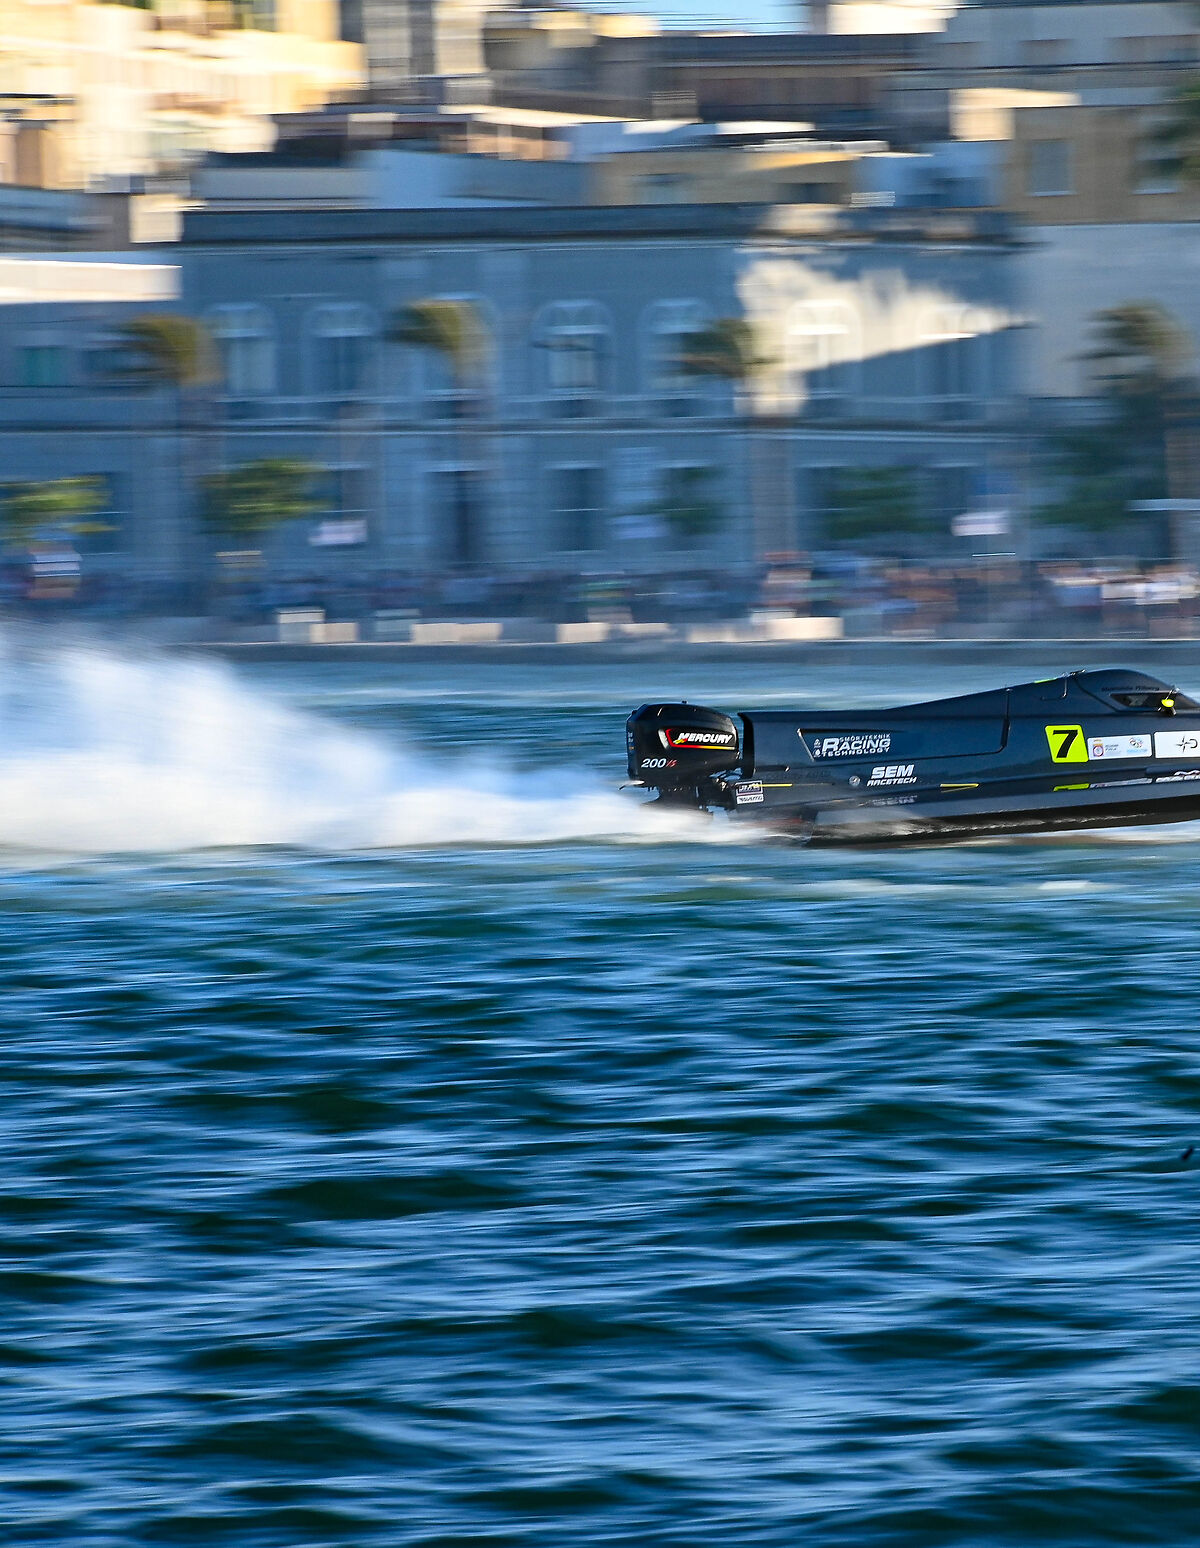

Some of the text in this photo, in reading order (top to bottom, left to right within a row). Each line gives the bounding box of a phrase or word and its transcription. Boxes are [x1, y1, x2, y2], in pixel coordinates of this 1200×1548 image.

[675, 732, 733, 744] MERCURY
[1053, 729, 1079, 759] 7
[822, 747, 890, 757] TECHNOLOGY
[640, 758, 666, 769] 200
[871, 764, 915, 780] SEM
